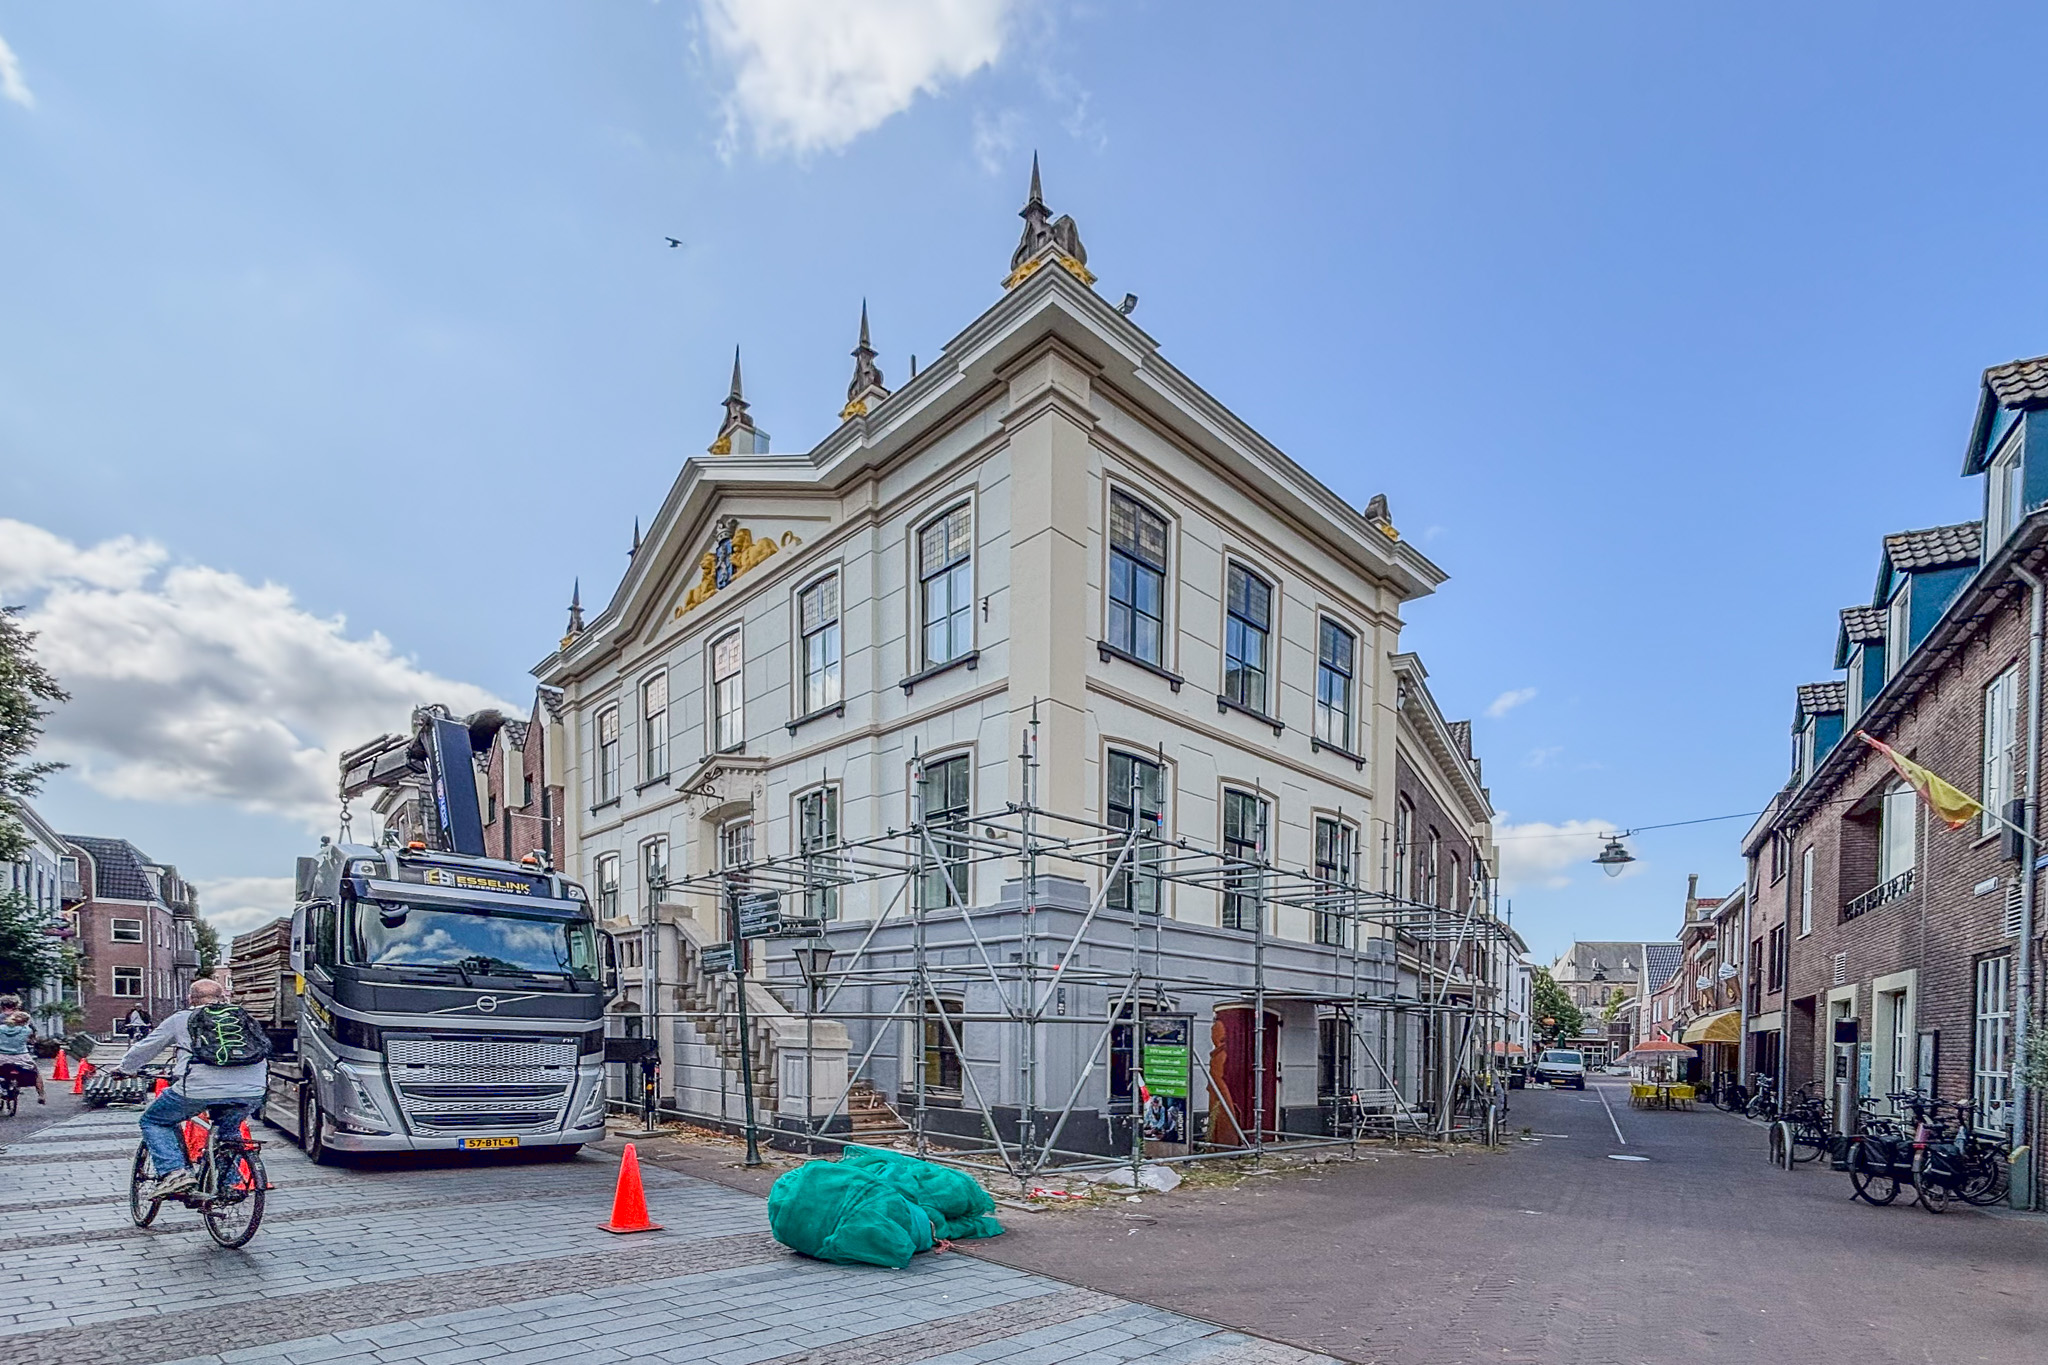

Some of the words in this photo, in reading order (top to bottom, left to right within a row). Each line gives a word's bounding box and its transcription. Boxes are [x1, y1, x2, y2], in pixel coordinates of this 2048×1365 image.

[456, 876, 531, 891] ESSELINK
[457, 883, 514, 893] STEIGERBOUW
[468, 1138, 514, 1148] 57-BTL-4
